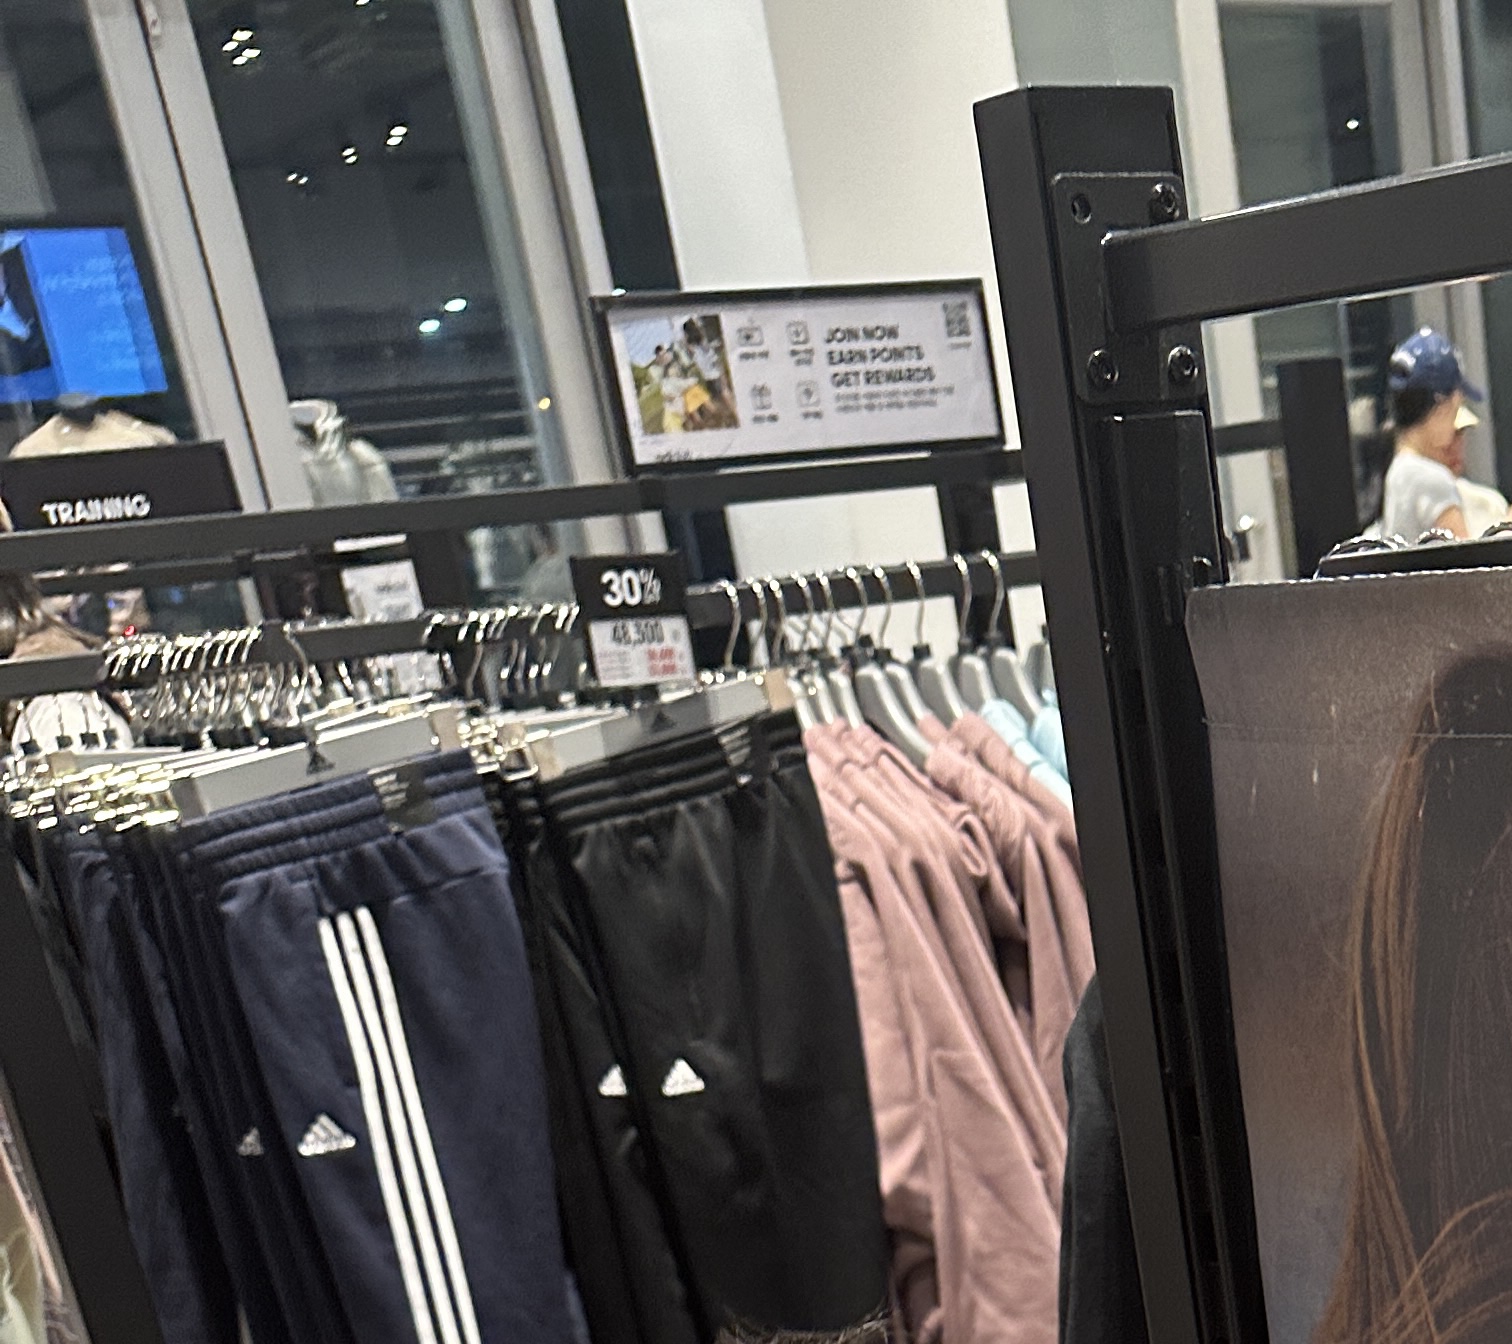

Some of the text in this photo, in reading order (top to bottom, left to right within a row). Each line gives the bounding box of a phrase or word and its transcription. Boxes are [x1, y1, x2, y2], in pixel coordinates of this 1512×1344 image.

[825, 323, 899, 344] JOIN NOW
[827, 349, 867, 366] EARN
[869, 345, 925, 363] POINTS
[831, 366, 936, 388] GET REWARDS
[41, 493, 151, 526] TRAINING
[600, 567, 661, 607] 30%
